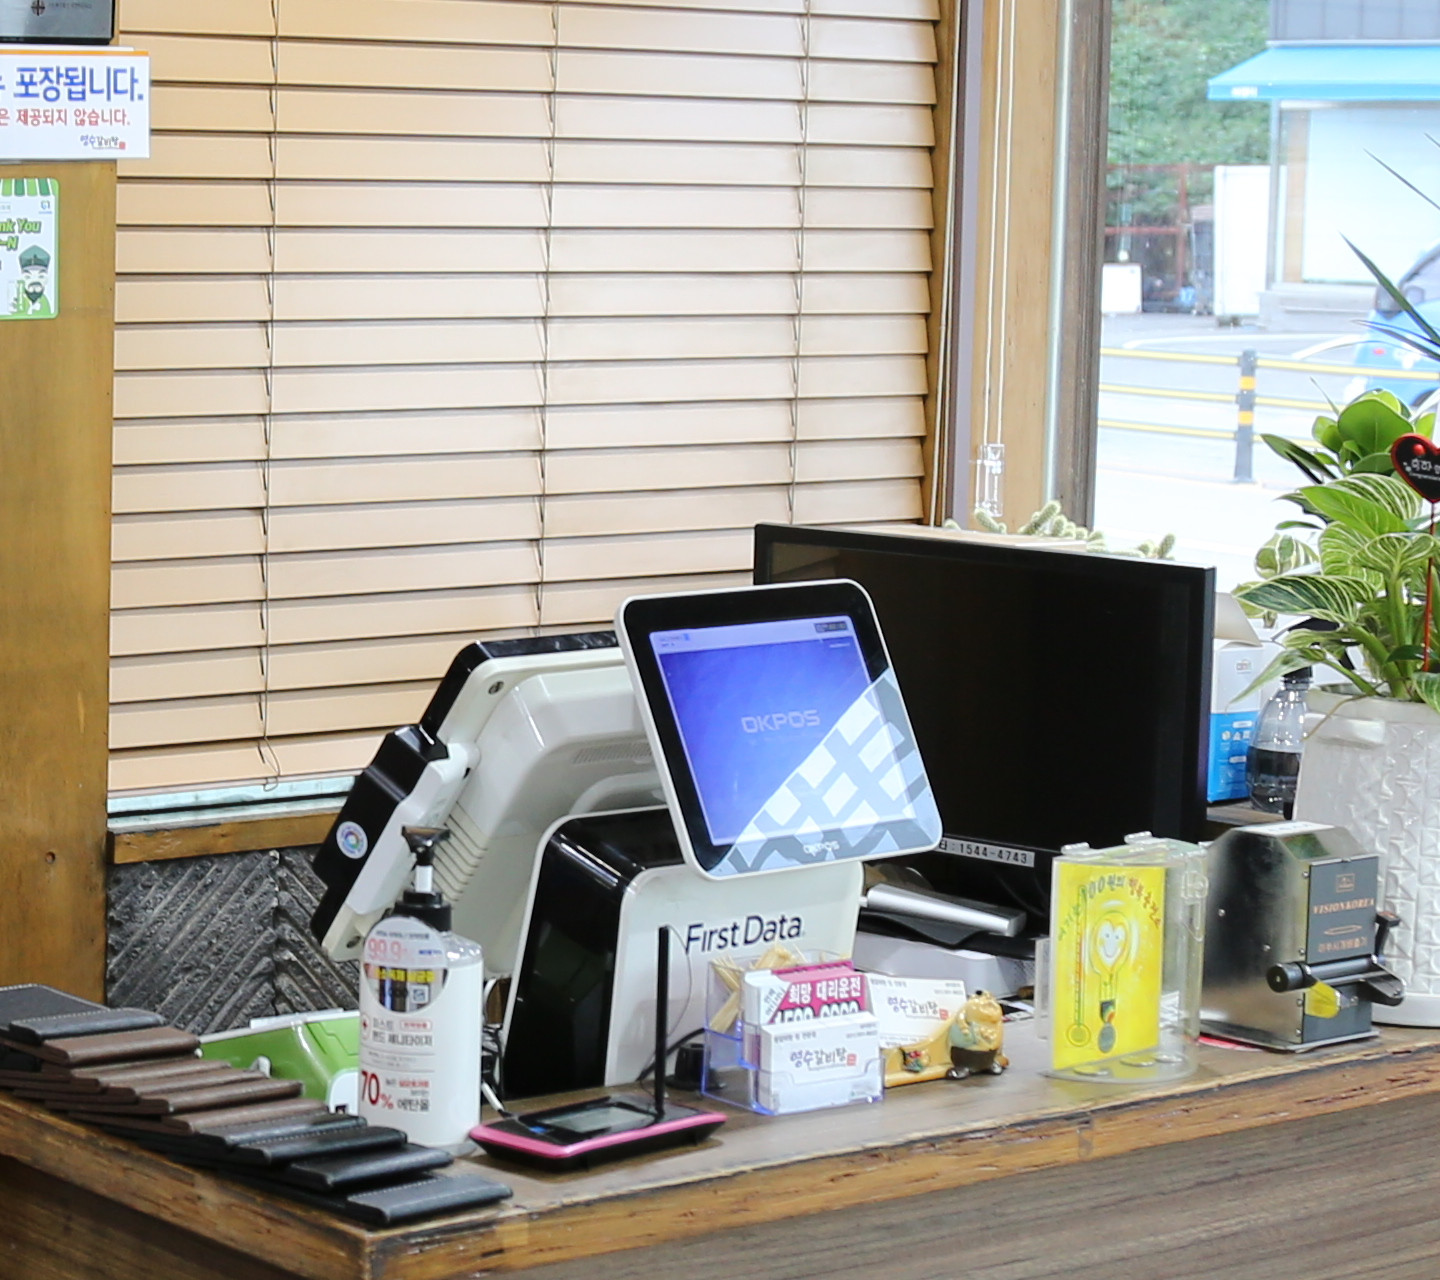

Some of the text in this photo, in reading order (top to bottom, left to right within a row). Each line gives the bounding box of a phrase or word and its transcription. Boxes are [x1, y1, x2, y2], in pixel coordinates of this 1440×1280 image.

[13, 66, 144, 102] 포장됩니다.
[16, 108, 68, 126] 제공되지
[74, 108, 131, 127] 않습니다.
[17, 218, 42, 234] You
[741, 709, 820, 733] OKPOS
[959, 843, 1028, 864] 1544-4743
[686, 915, 803, 955] First Data
[788, 982, 812, 1004] 희망
[816, 976, 861, 1001] 대리운전
